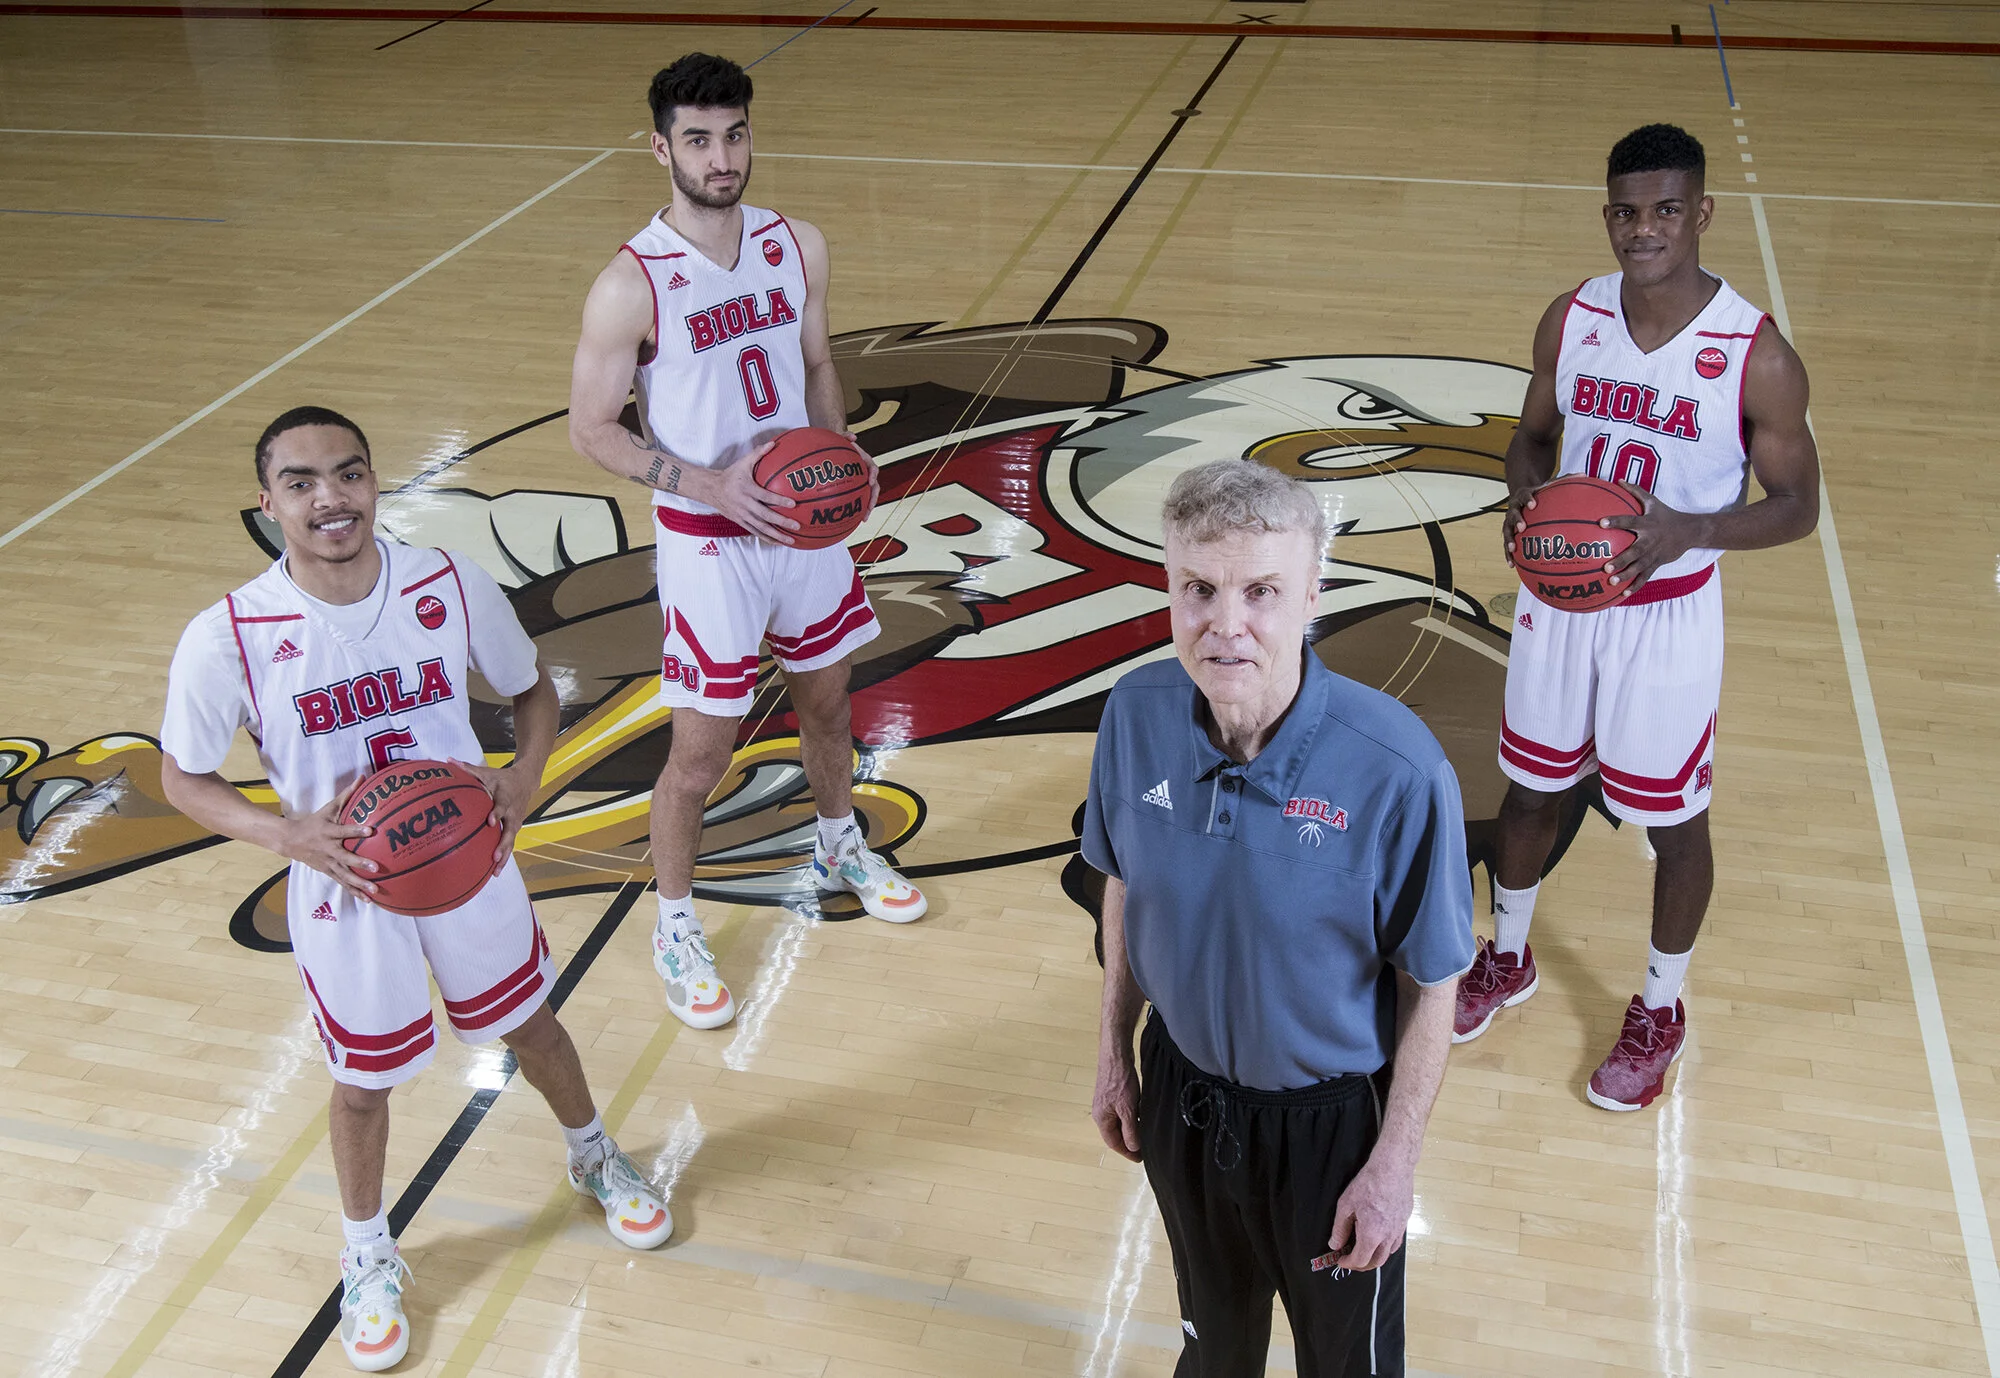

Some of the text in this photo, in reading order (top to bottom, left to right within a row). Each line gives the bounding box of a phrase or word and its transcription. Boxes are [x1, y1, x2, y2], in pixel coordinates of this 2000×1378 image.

[667, 279, 691, 291] adidas
[684, 287, 798, 354] BIOLA
[736, 343, 781, 422] 0
[1571, 373, 1702, 442] BIOLA
[786, 459, 864, 493] Wilson
[1585, 433, 1662, 495] 10
[810, 496, 863, 525] NCAA
[1521, 533, 1612, 561] Wilson
[1537, 580, 1605, 600] NCAA
[272, 648, 305, 664] adidas
[663, 653, 700, 693] BU
[292, 656, 455, 738] BIOLA
[350, 767, 453, 825] Wilson
[1142, 791, 1174, 811] adidas
[1282, 796, 1350, 833] BIOLA
[385, 797, 463, 853] NCAA
[311, 911, 337, 922] adidas
